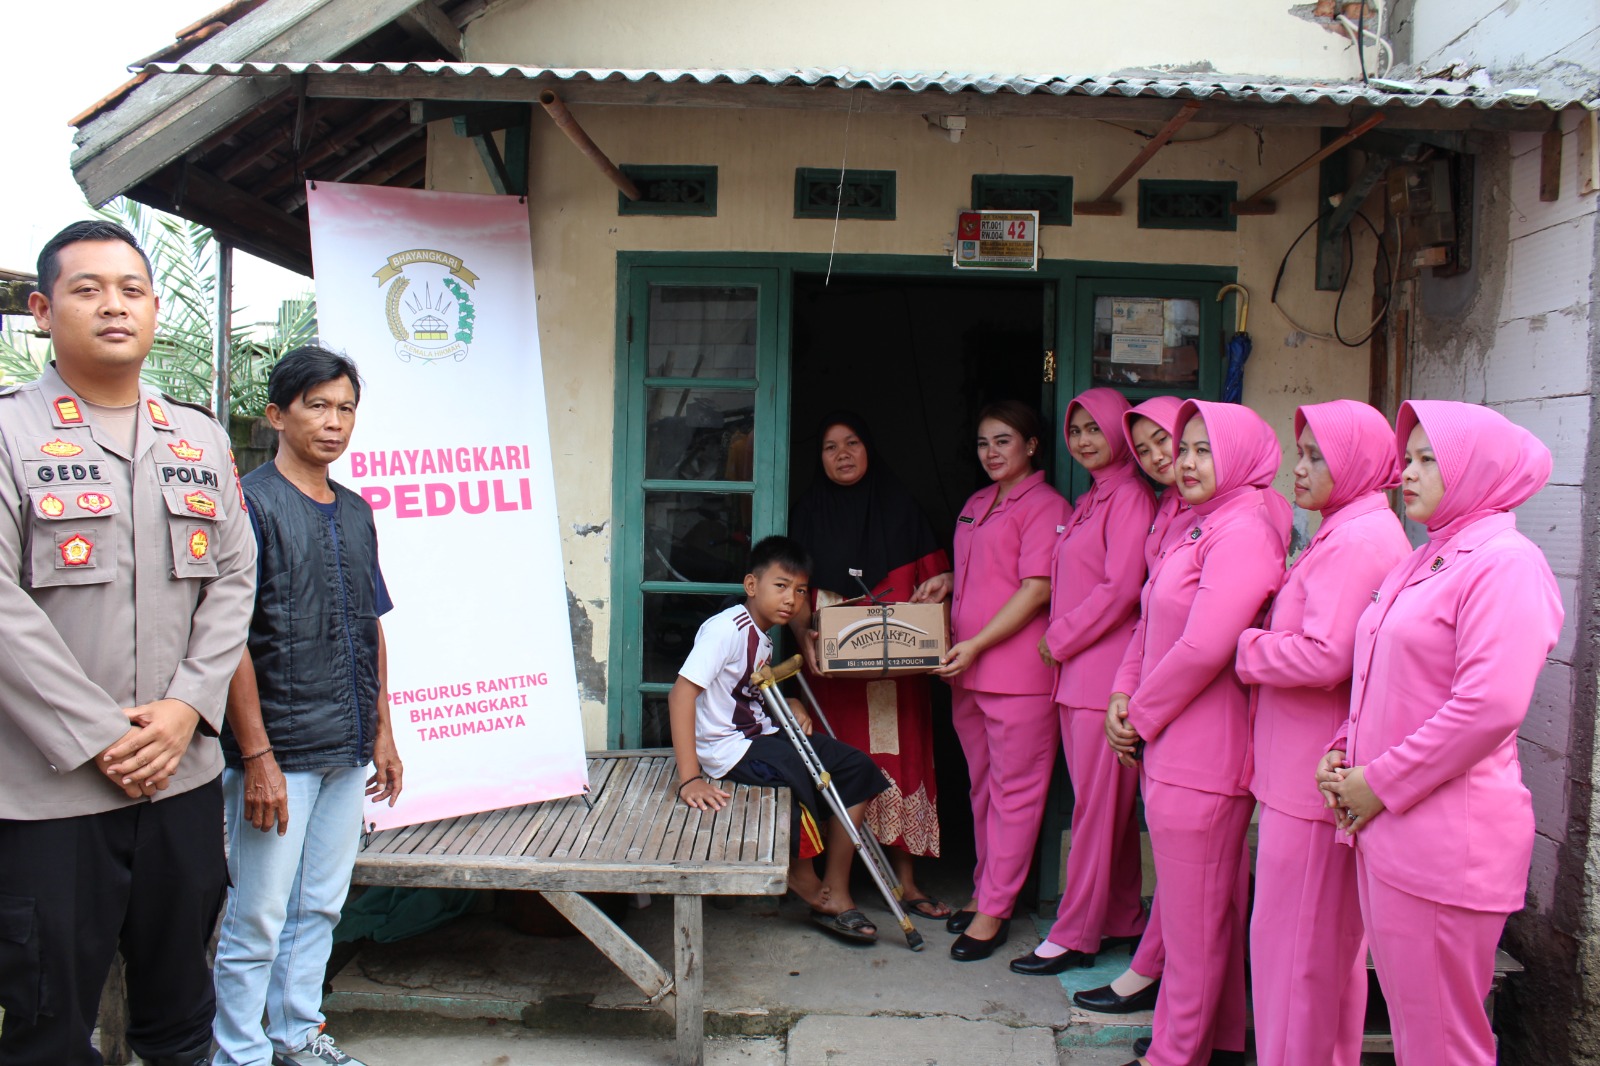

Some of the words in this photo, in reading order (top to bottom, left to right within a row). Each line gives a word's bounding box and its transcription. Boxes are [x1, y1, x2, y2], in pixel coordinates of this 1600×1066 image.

[981, 221, 1001, 230] RT.001
[981, 231, 1003, 240] RW.004
[1008, 220, 1026, 239] 42
[392, 251, 458, 268] BHAYANGKARI
[403, 343, 433, 357] KEMALA
[434, 343, 461, 357] HIKMAH
[350, 444, 531, 478] BHAYANGKARI
[37, 464, 103, 482] GEDE
[162, 466, 218, 488] POLRI
[361, 478, 533, 519] PEDULI
[476, 672, 548, 694] RANTING
[409, 694, 528, 723] BHAYANGKARI
[417, 714, 526, 742] TARUMAJAYA
